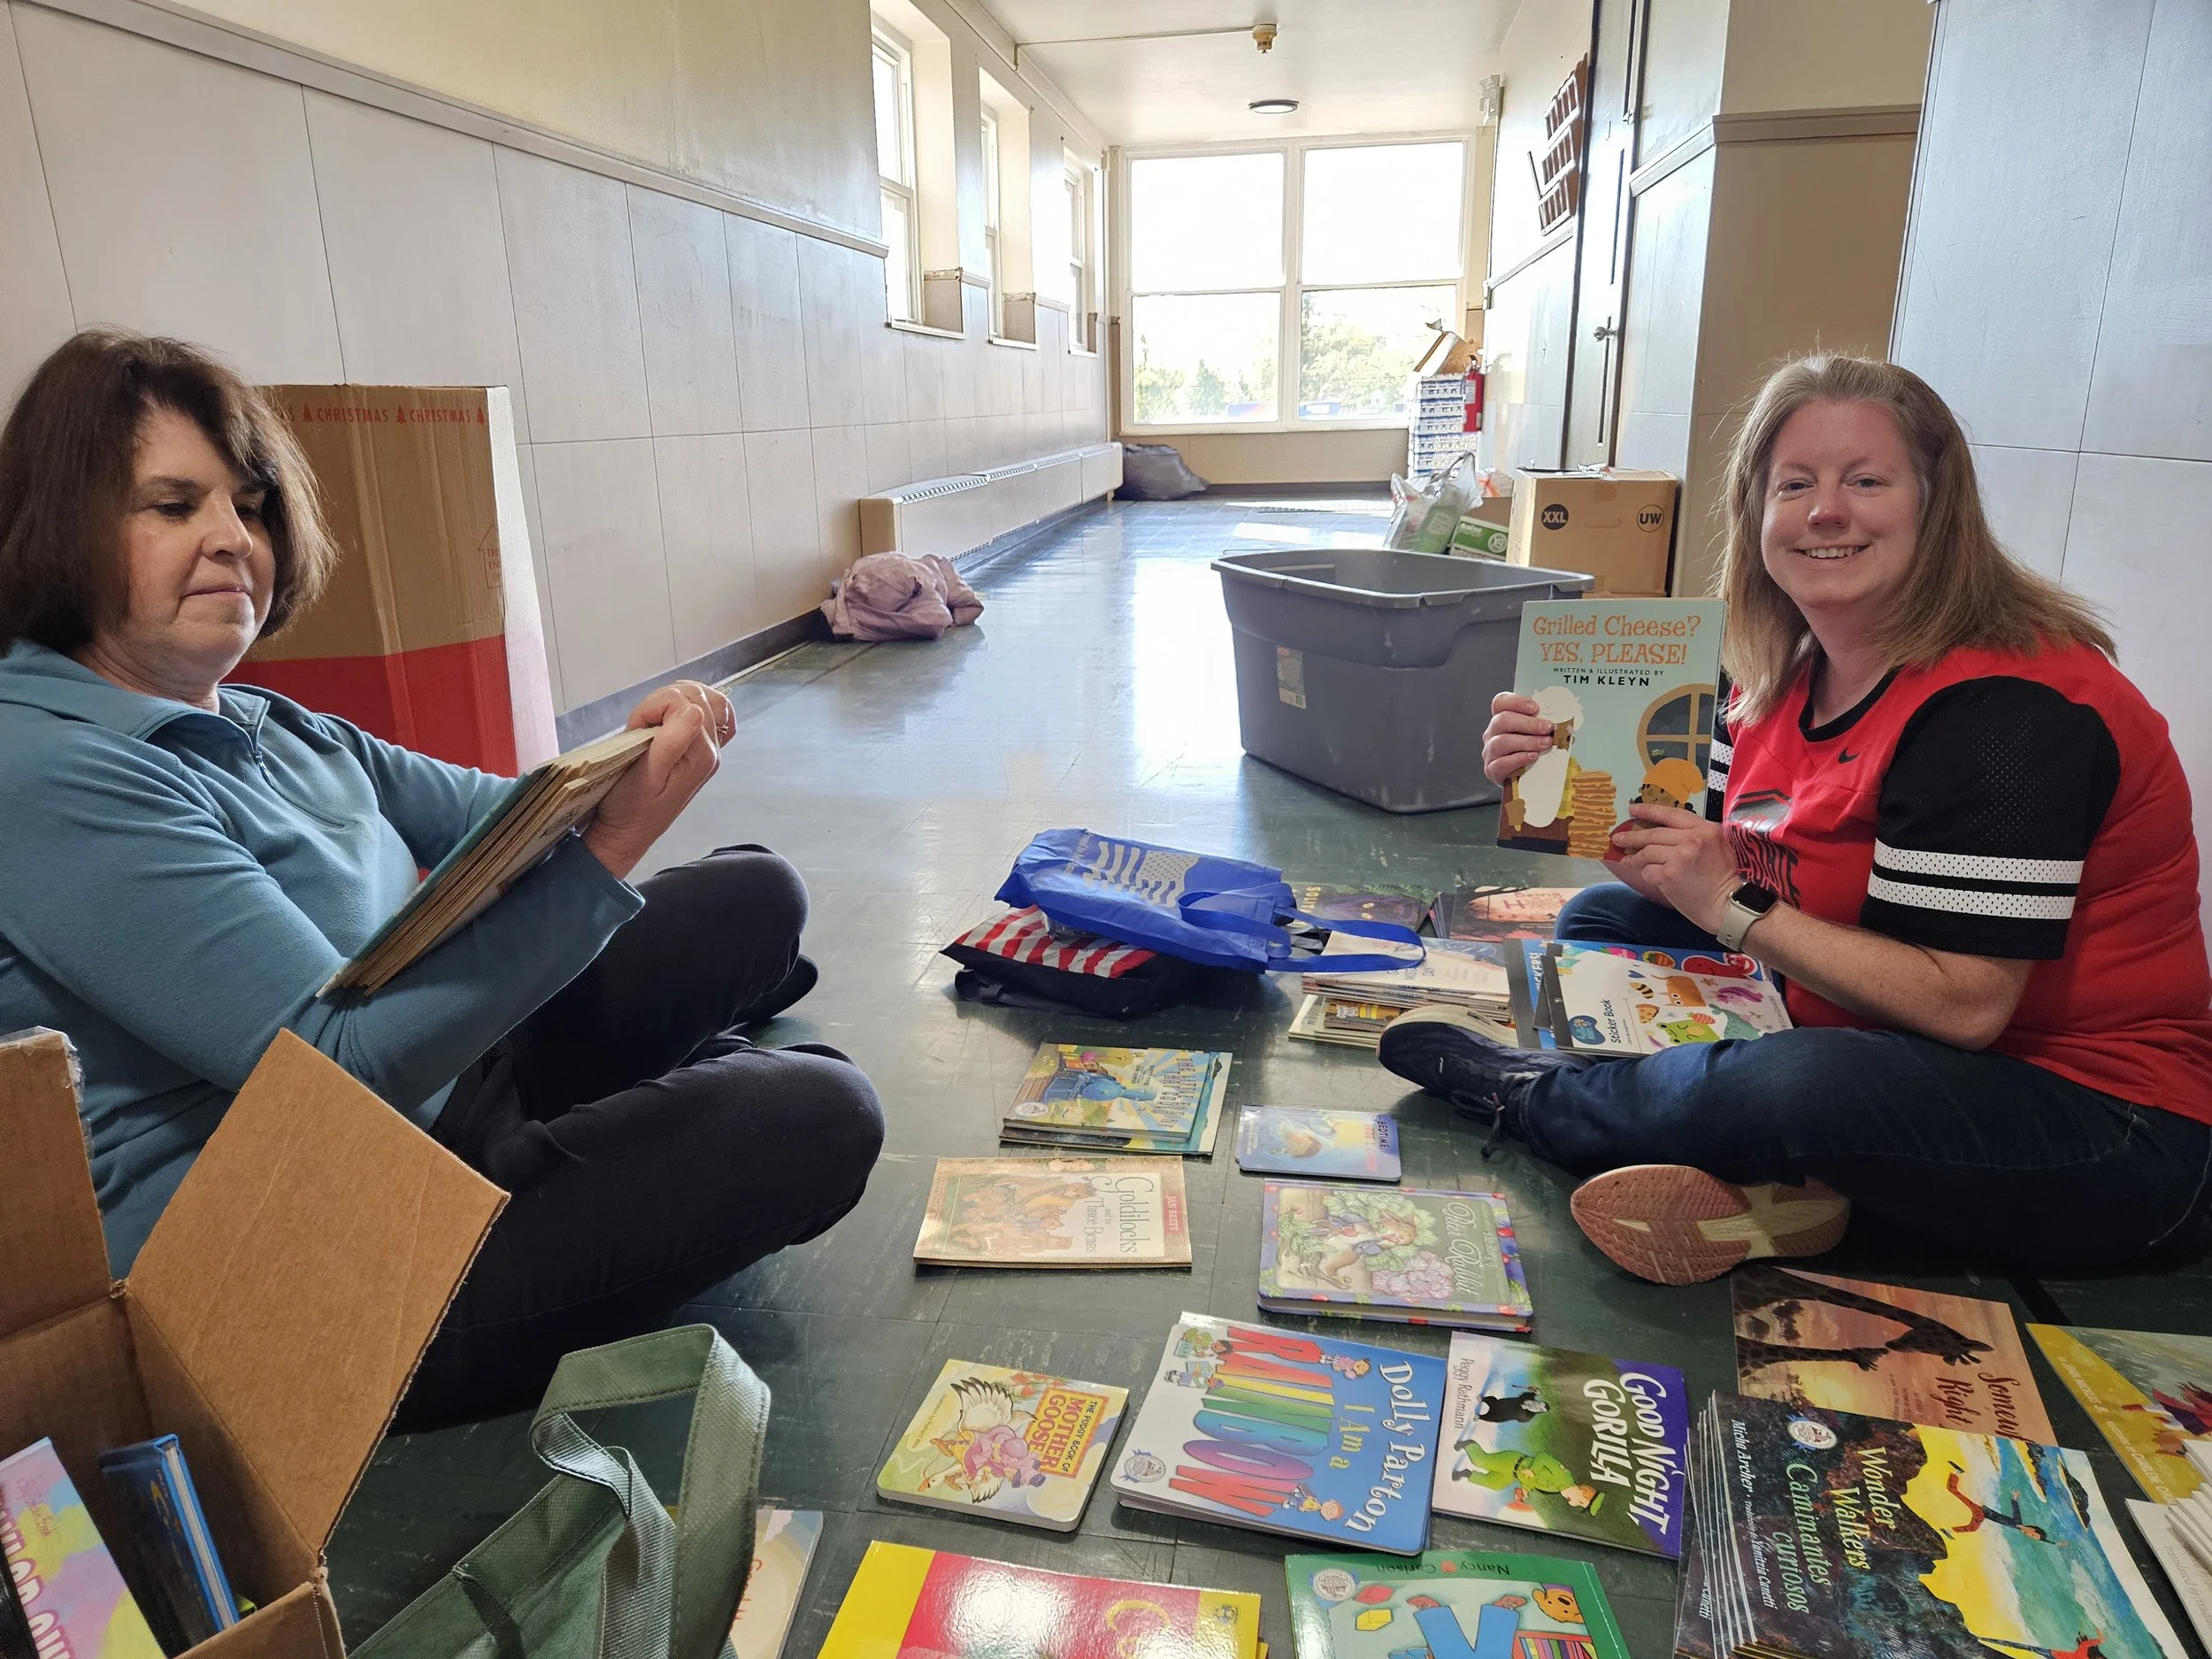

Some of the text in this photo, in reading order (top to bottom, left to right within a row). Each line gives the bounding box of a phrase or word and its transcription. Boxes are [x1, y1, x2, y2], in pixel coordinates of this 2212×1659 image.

[318, 408, 388, 423] CHRISTMAS
[410, 408, 471, 423] CHRISTMAS
[1543, 511, 1566, 523] XXL
[1640, 513, 1662, 524] UW
[1533, 615, 1701, 637] Grilled Cheese?
[1591, 643, 1687, 664] PLEASE!
[1563, 675, 1649, 686] TIM KLEYN
[1601, 999, 1621, 1043] Sticker Book
[1087, 1176, 1154, 1253] Goldilocks
[1166, 1195, 1179, 1231] JAN BRETT
[1442, 1202, 1483, 1294] Peter Rabbit
[1452, 1358, 1475, 1430] Peggy Rathmann
[1930, 1377, 1981, 1425] Right
[1029, 1394, 1067, 1452] GOOSE
[1042, 1397, 1087, 1469] MOTHER
[1064, 1401, 1097, 1472] THE PUDGY BOOK OF
[1169, 1325, 1335, 1518] RAINBOW
[1328, 1404, 1375, 1470] I Am a
[1345, 1362, 1430, 1533] Dolly Parton
[1583, 1379, 1632, 1488] GORILLA
[1732, 1419, 1748, 1453] Micha
[1619, 1372, 1685, 1534] GOOD NIGHT,
[1737, 1452, 1756, 1493] Archer
[1856, 1447, 1901, 1530] Wonder
[1786, 1463, 1832, 1586] Caminantes
[1829, 1487, 1871, 1570] Walkers
[1377, 1561, 1510, 1575] Nancy Carlson
[1751, 1540, 1768, 1577] Yanitzia
[1772, 1532, 1809, 1614] curiosos
[1757, 1575, 1778, 1609] Canetti
